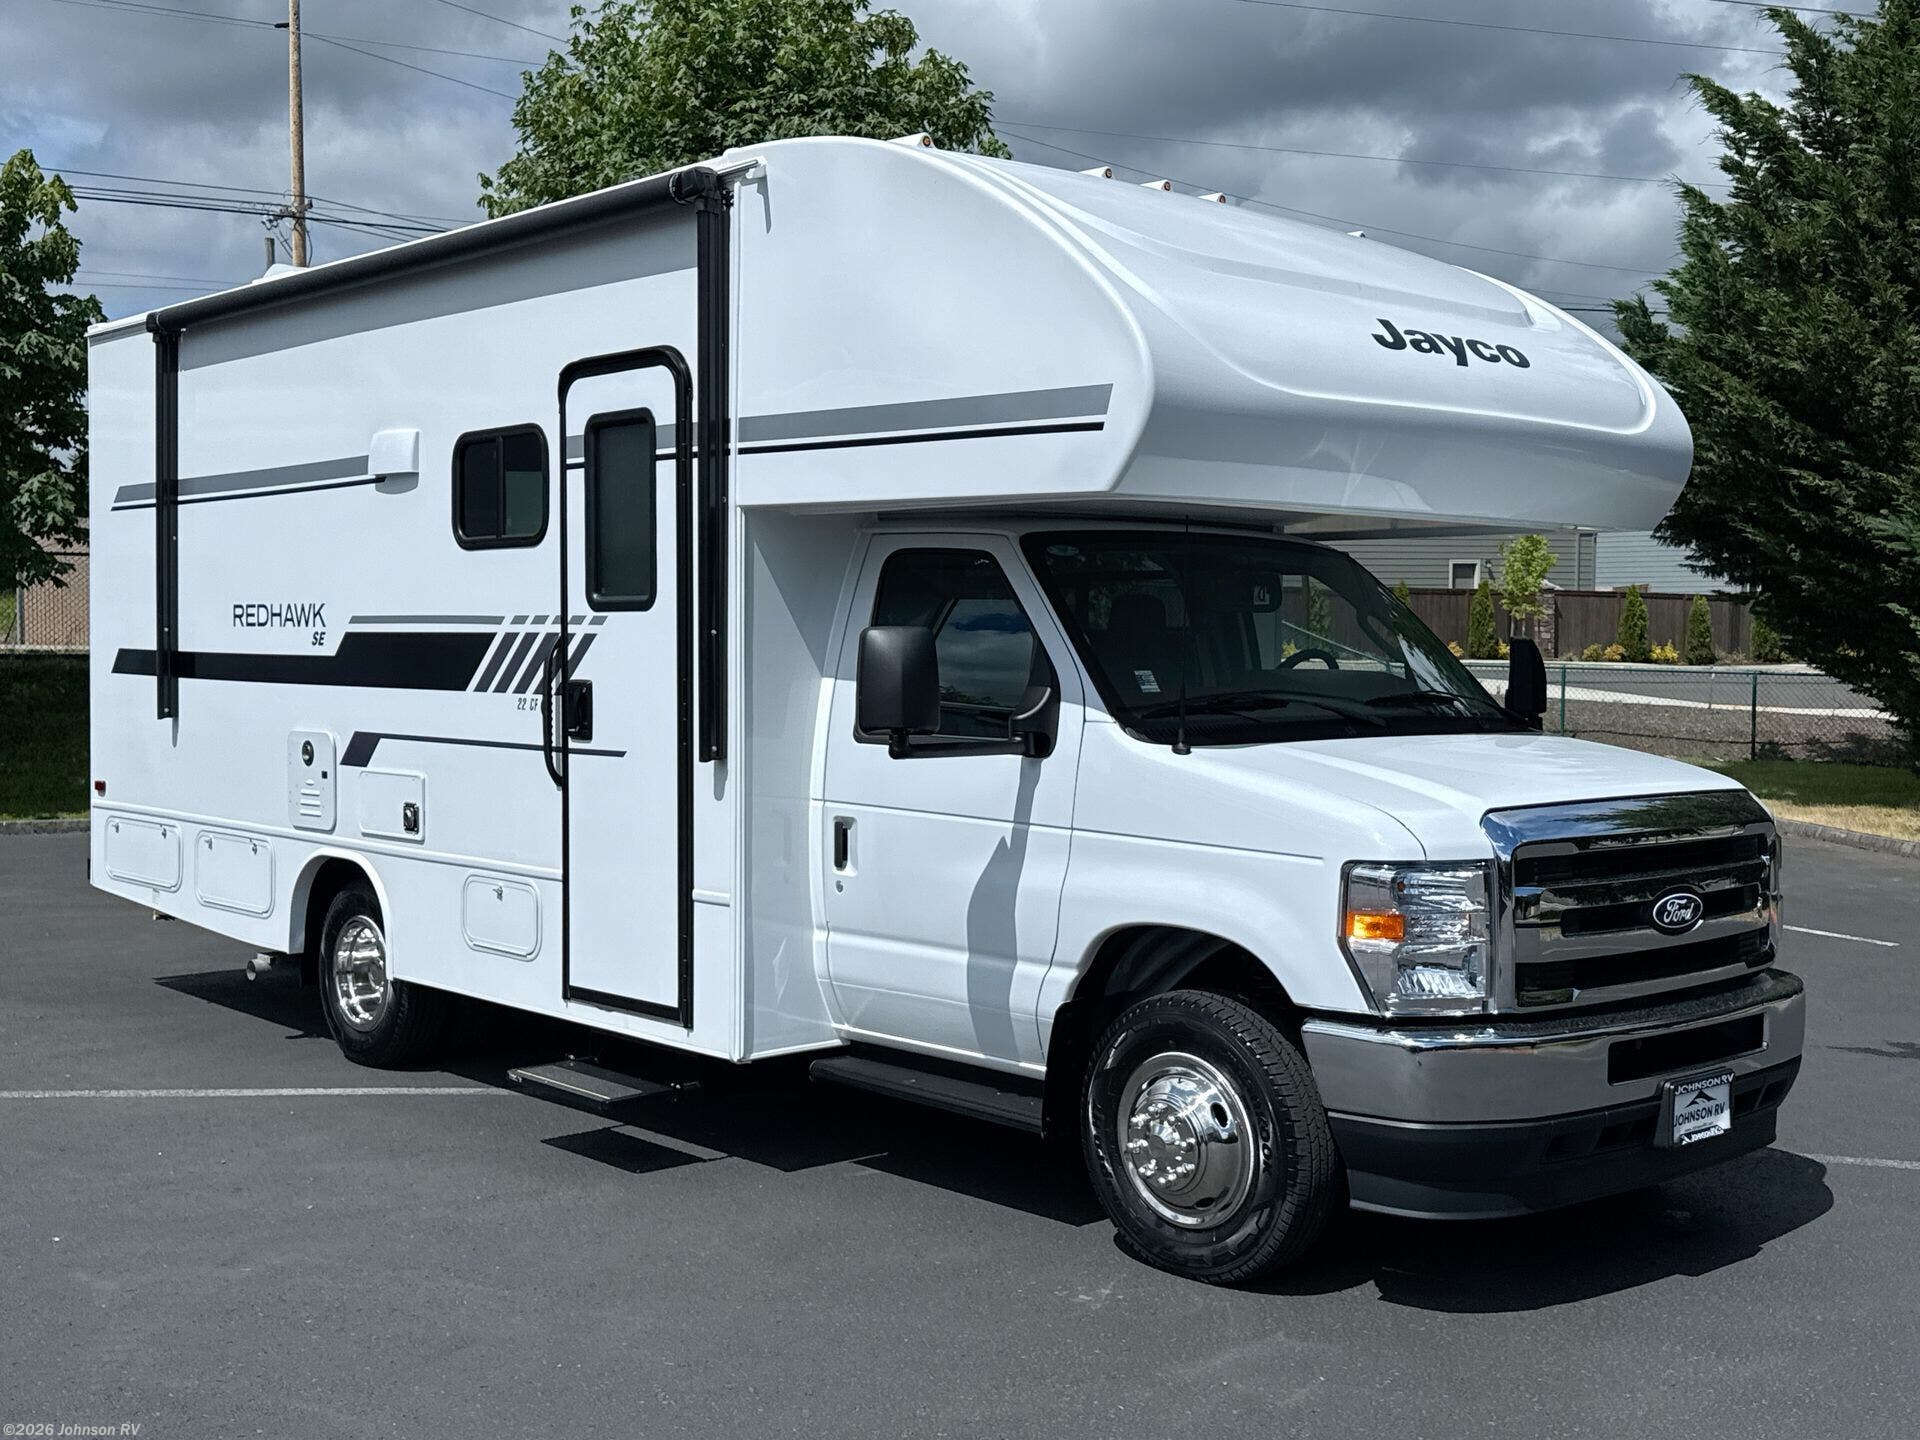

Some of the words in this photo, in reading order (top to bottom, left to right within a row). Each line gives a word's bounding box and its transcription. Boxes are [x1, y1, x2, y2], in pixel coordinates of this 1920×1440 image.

[1371, 318, 1531, 368] Jayco
[233, 603, 326, 627] REDHAWK
[312, 631, 326, 646] SE
[517, 697, 527, 710] 22
[530, 698, 538, 711] CF
[1663, 899, 1695, 923] Ford
[1675, 1077, 1720, 1096] JOHNSON
[1721, 1073, 1735, 1085] RV
[1674, 1105, 1713, 1127] JOHNSON
[1714, 1102, 1725, 1115] RV
